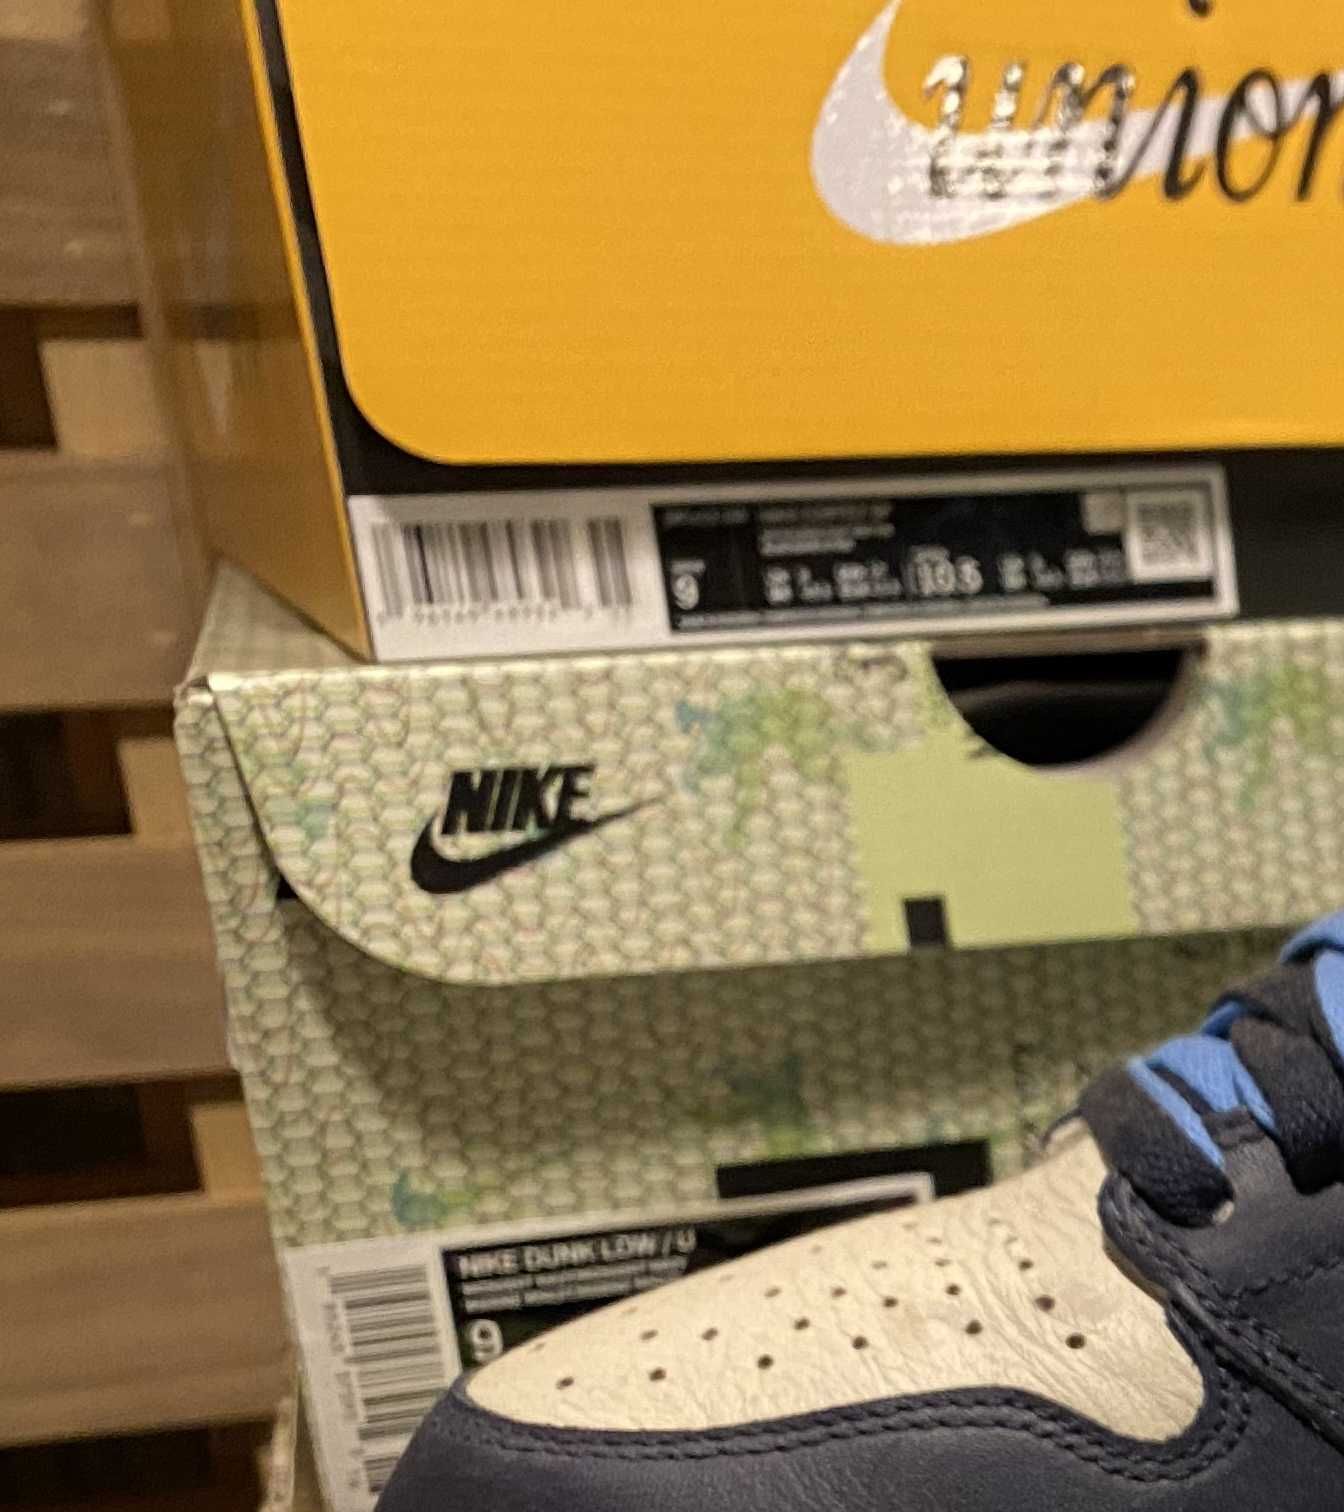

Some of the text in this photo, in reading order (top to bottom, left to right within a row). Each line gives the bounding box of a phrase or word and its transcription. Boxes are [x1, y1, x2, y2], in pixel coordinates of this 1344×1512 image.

[441, 764, 596, 834] NIKE
[459, 1250, 519, 1280] NIKE
[524, 1240, 596, 1273] DUNK
[467, 1317, 504, 1364] 9
